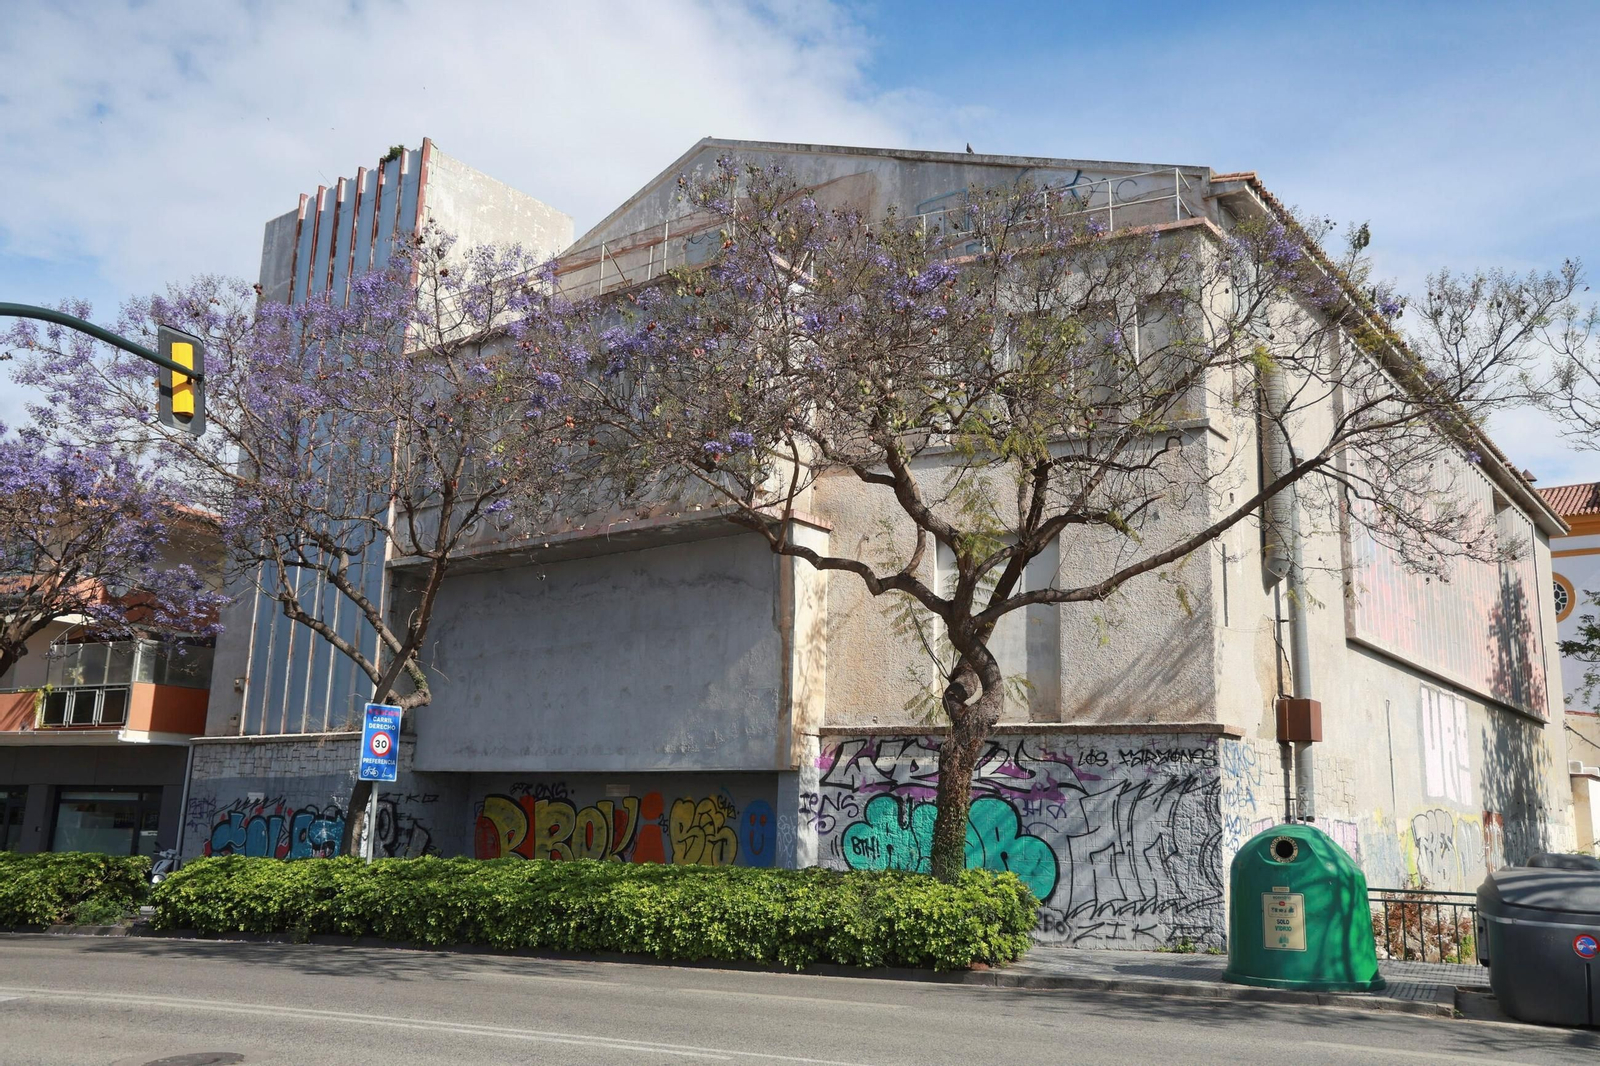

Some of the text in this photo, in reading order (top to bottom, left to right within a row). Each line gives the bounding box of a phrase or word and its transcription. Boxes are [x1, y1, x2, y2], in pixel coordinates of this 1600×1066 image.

[368, 722, 396, 731] DERECHO
[374, 739, 388, 749] 30
[363, 757, 396, 766] PREFERENCIA
